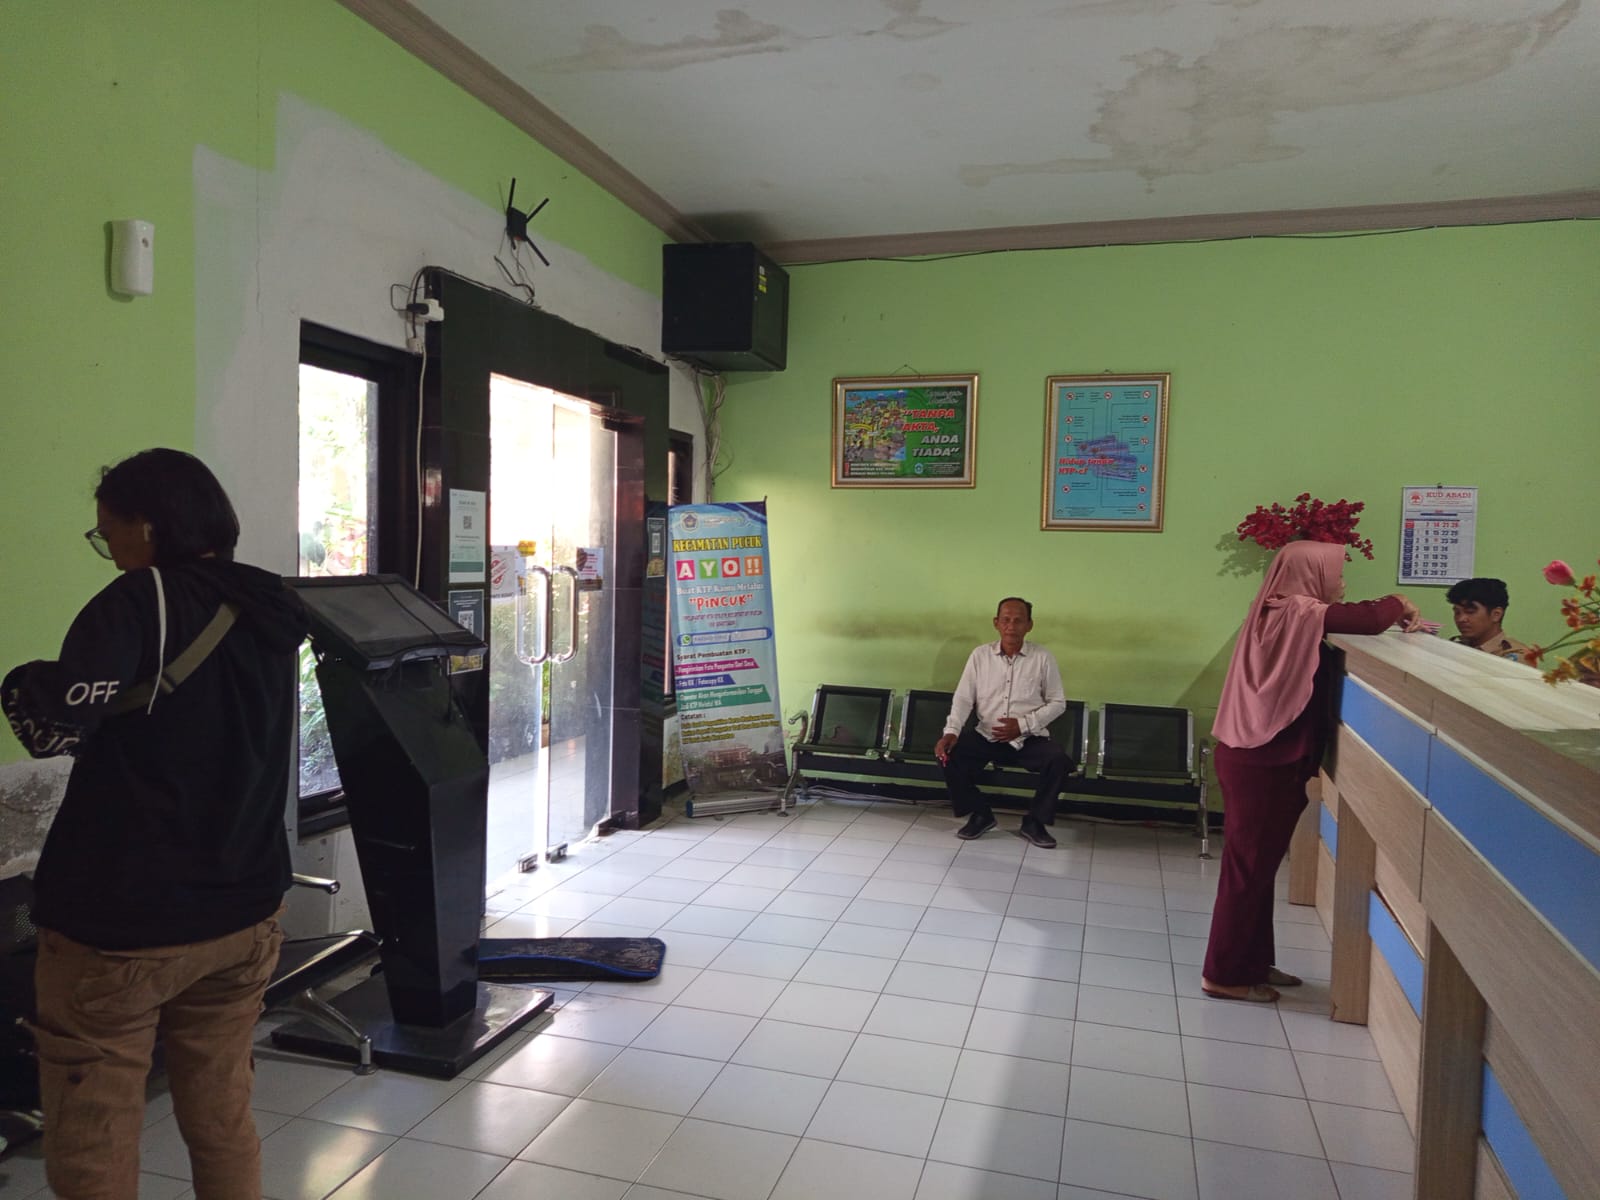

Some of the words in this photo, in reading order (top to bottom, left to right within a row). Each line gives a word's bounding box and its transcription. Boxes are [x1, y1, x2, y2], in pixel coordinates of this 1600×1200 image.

[921, 434, 959, 445] ANDA
[672, 538, 729, 552] KECAMATAN
[677, 653, 697, 662] Syarat
[698, 650, 733, 659] Pembuatan
[65, 680, 120, 706] OFF
